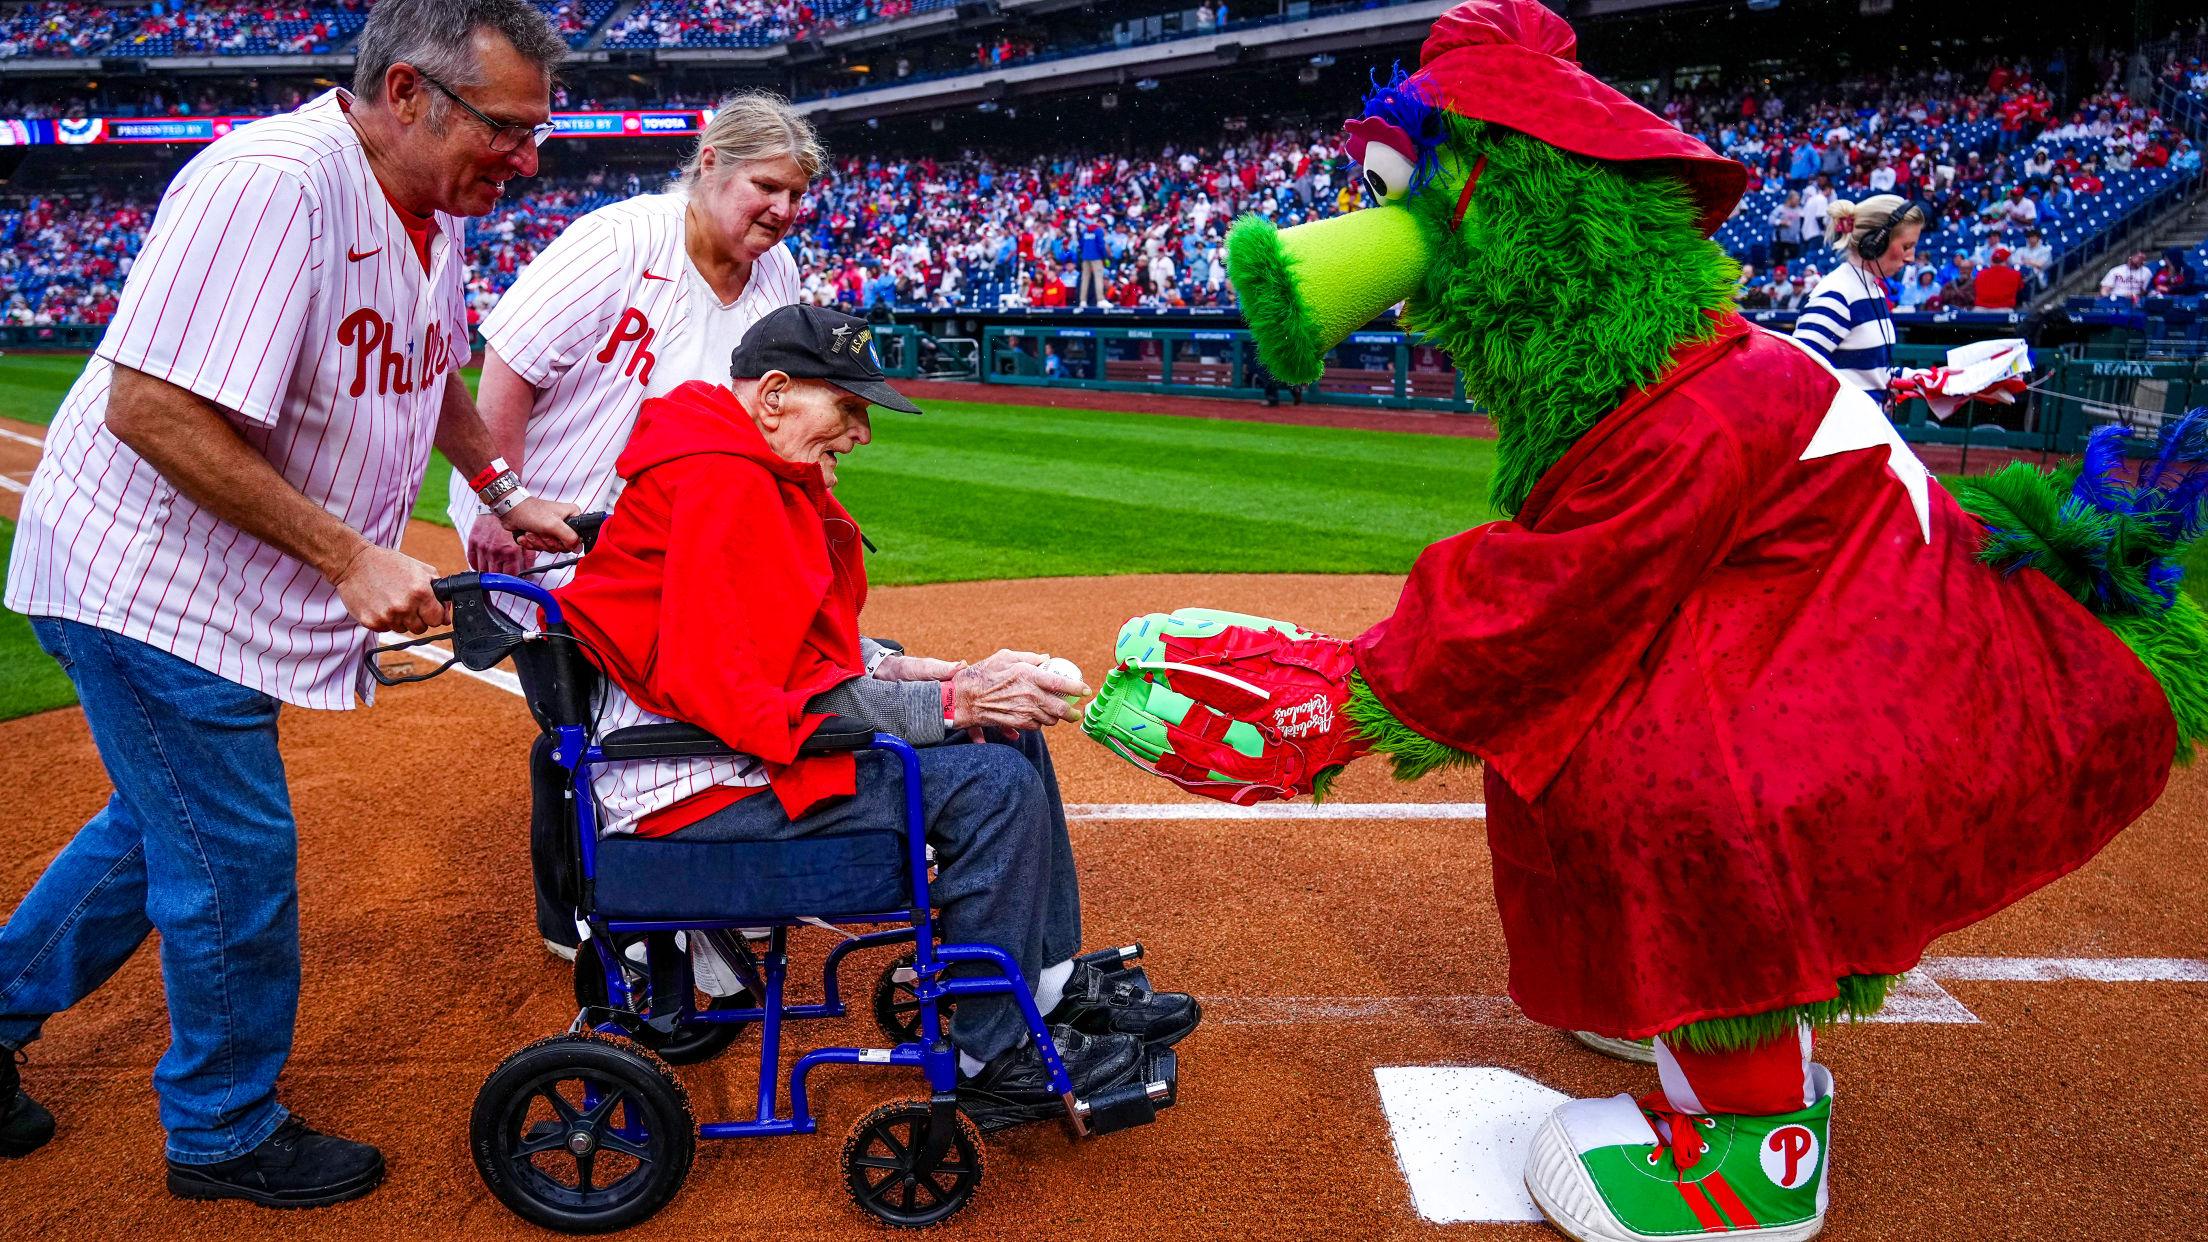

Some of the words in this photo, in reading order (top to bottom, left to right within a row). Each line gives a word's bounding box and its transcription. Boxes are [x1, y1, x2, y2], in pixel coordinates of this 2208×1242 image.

[117, 125, 185, 136] PRESENTED
[187, 125, 203, 135] BY
[597, 119, 613, 129] BY
[644, 118, 687, 129] TOYOTA
[2093, 362, 2155, 377] RE/MAX
[1273, 694, 1332, 725] Ridiculous
[1277, 711, 1335, 738] Absolutely
[1769, 1126, 1812, 1187] P
